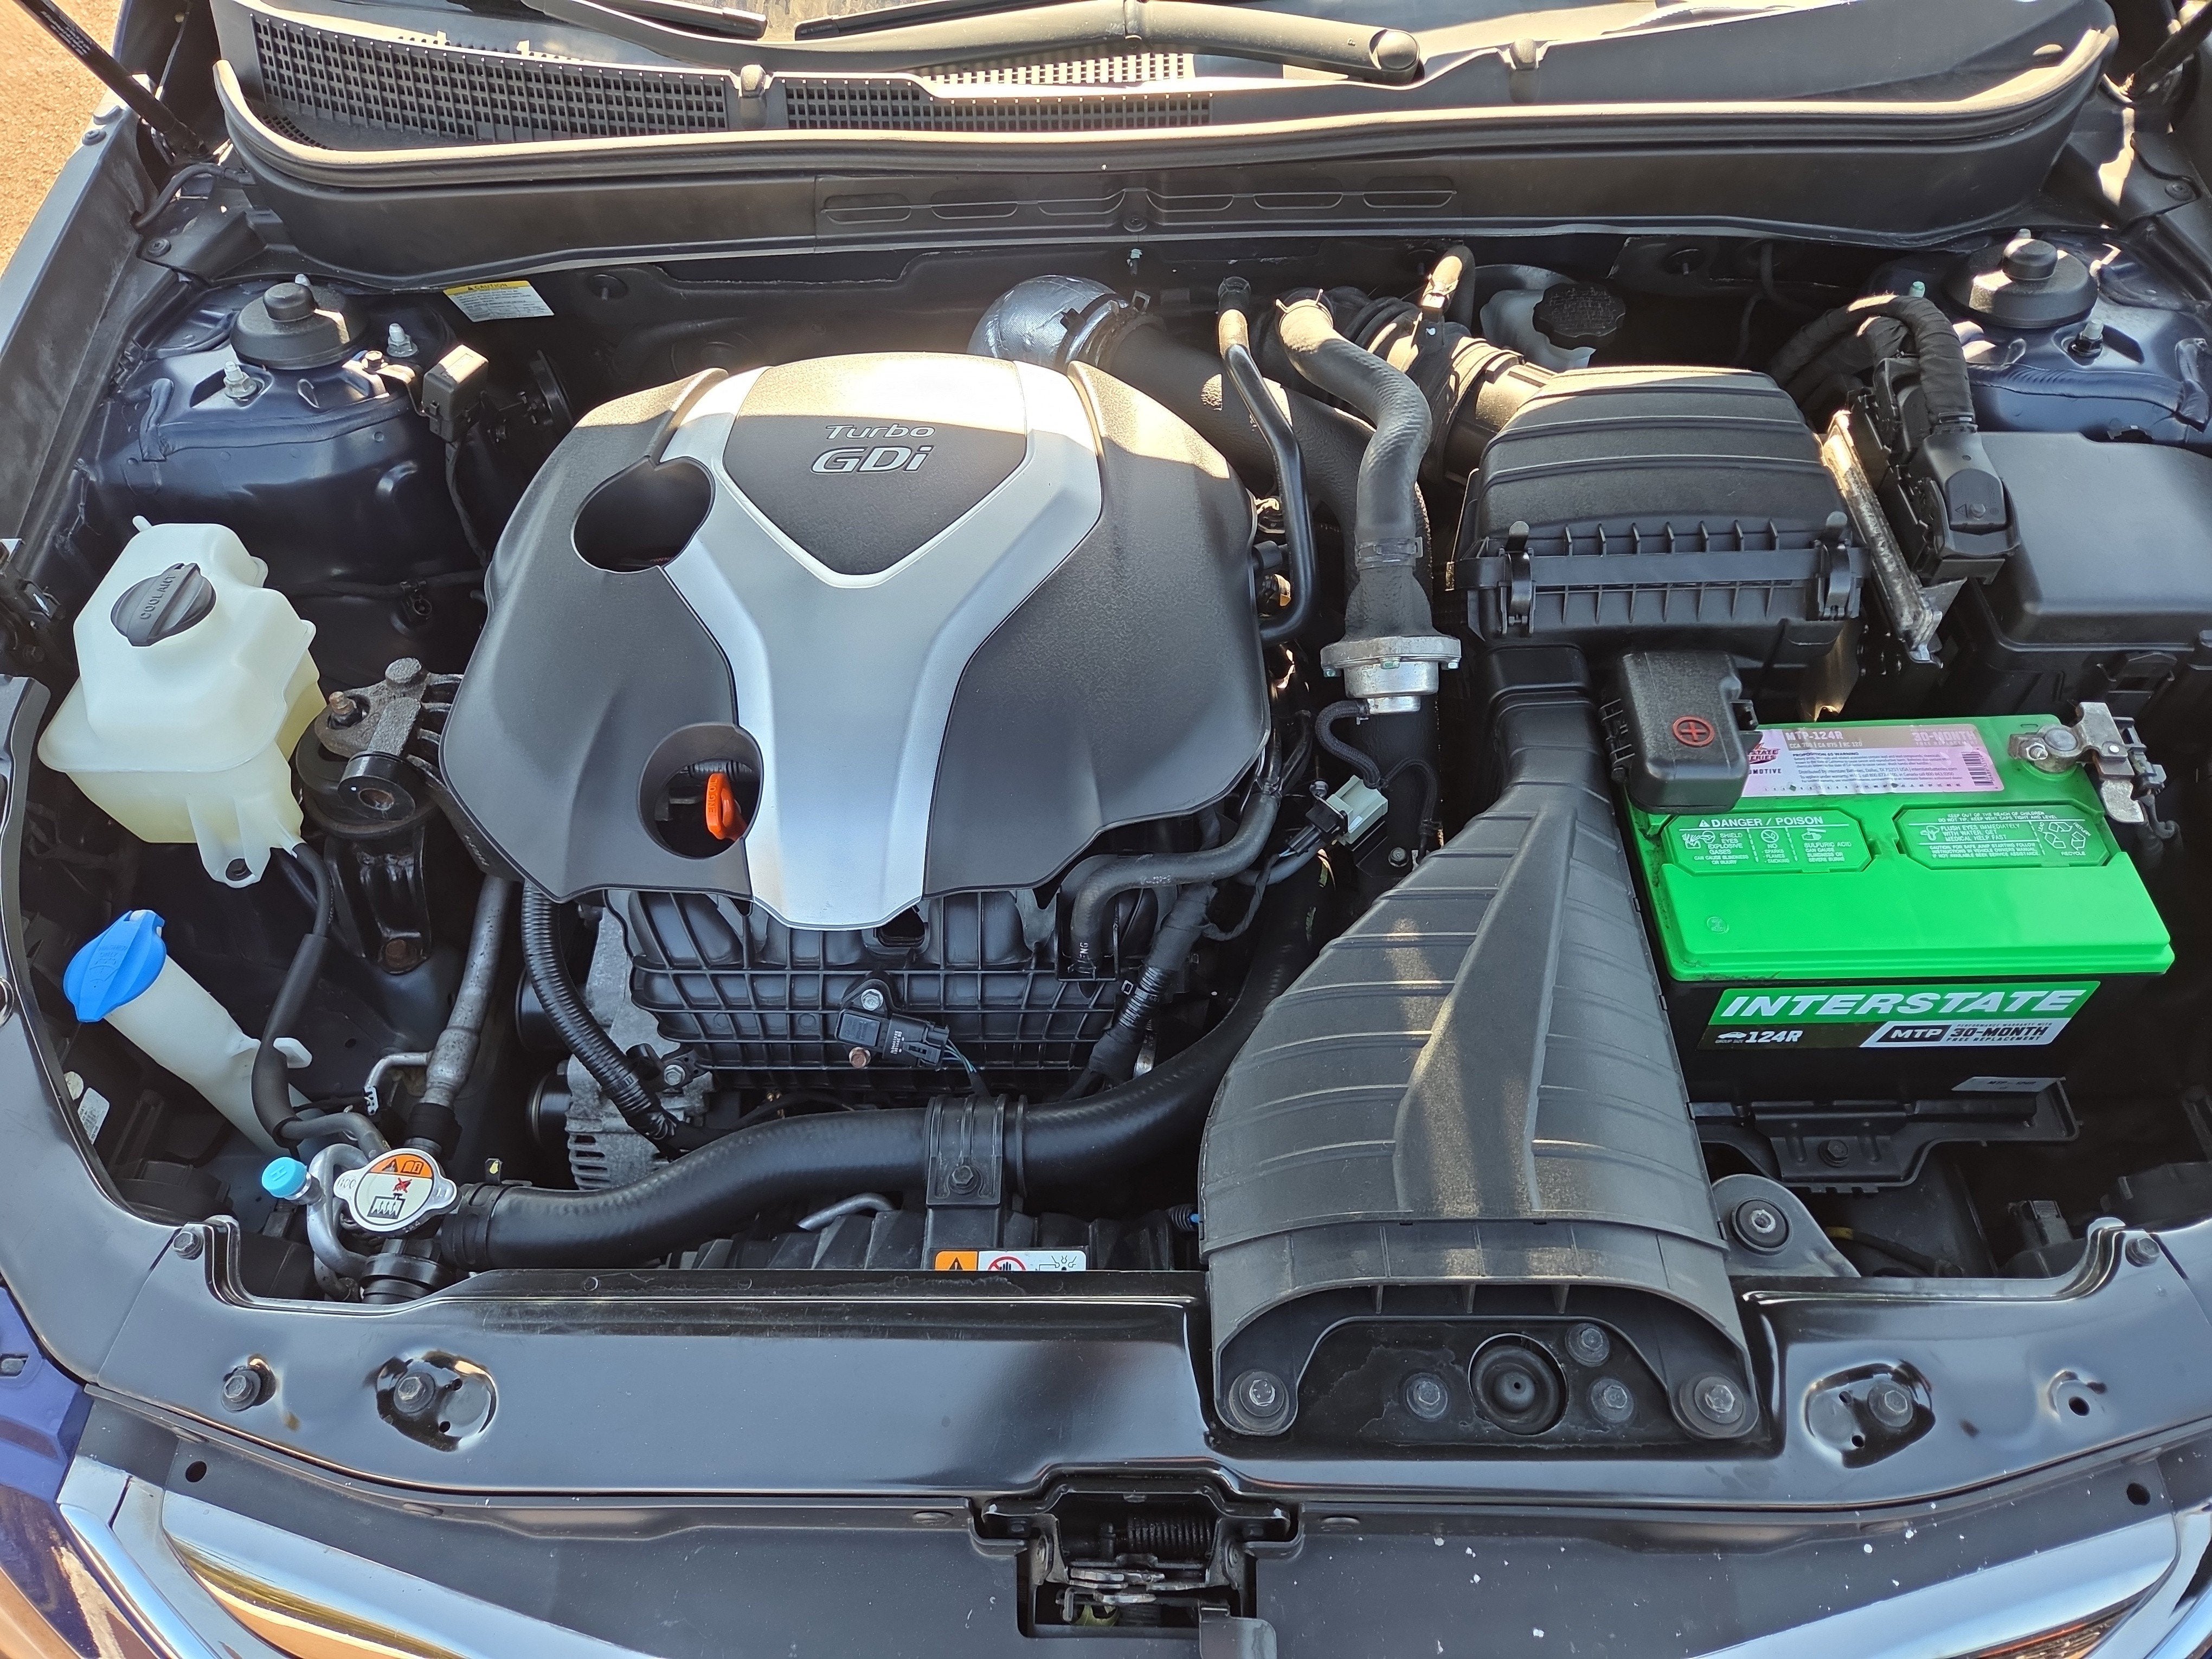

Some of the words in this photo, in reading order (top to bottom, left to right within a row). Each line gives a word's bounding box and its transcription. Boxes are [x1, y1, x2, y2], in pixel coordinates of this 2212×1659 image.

[825, 423, 935, 440] Turbo
[811, 445, 935, 473] GDi
[140, 575, 176, 620] COOLANT
[1785, 731, 1843, 741] MTP-124R
[1912, 731, 1977, 741] 30-MONTH
[1711, 818, 1763, 827] DANGER
[1766, 818, 1772, 826] /
[1776, 815, 1823, 825] POISON
[1721, 989, 2087, 1017] INTERSTATE
[1745, 1030, 1803, 1043] 124R
[1890, 1028, 1943, 1039] MTP
[1950, 1026, 2049, 1037] 30-MONTH
[271, 1166, 287, 1182] H
